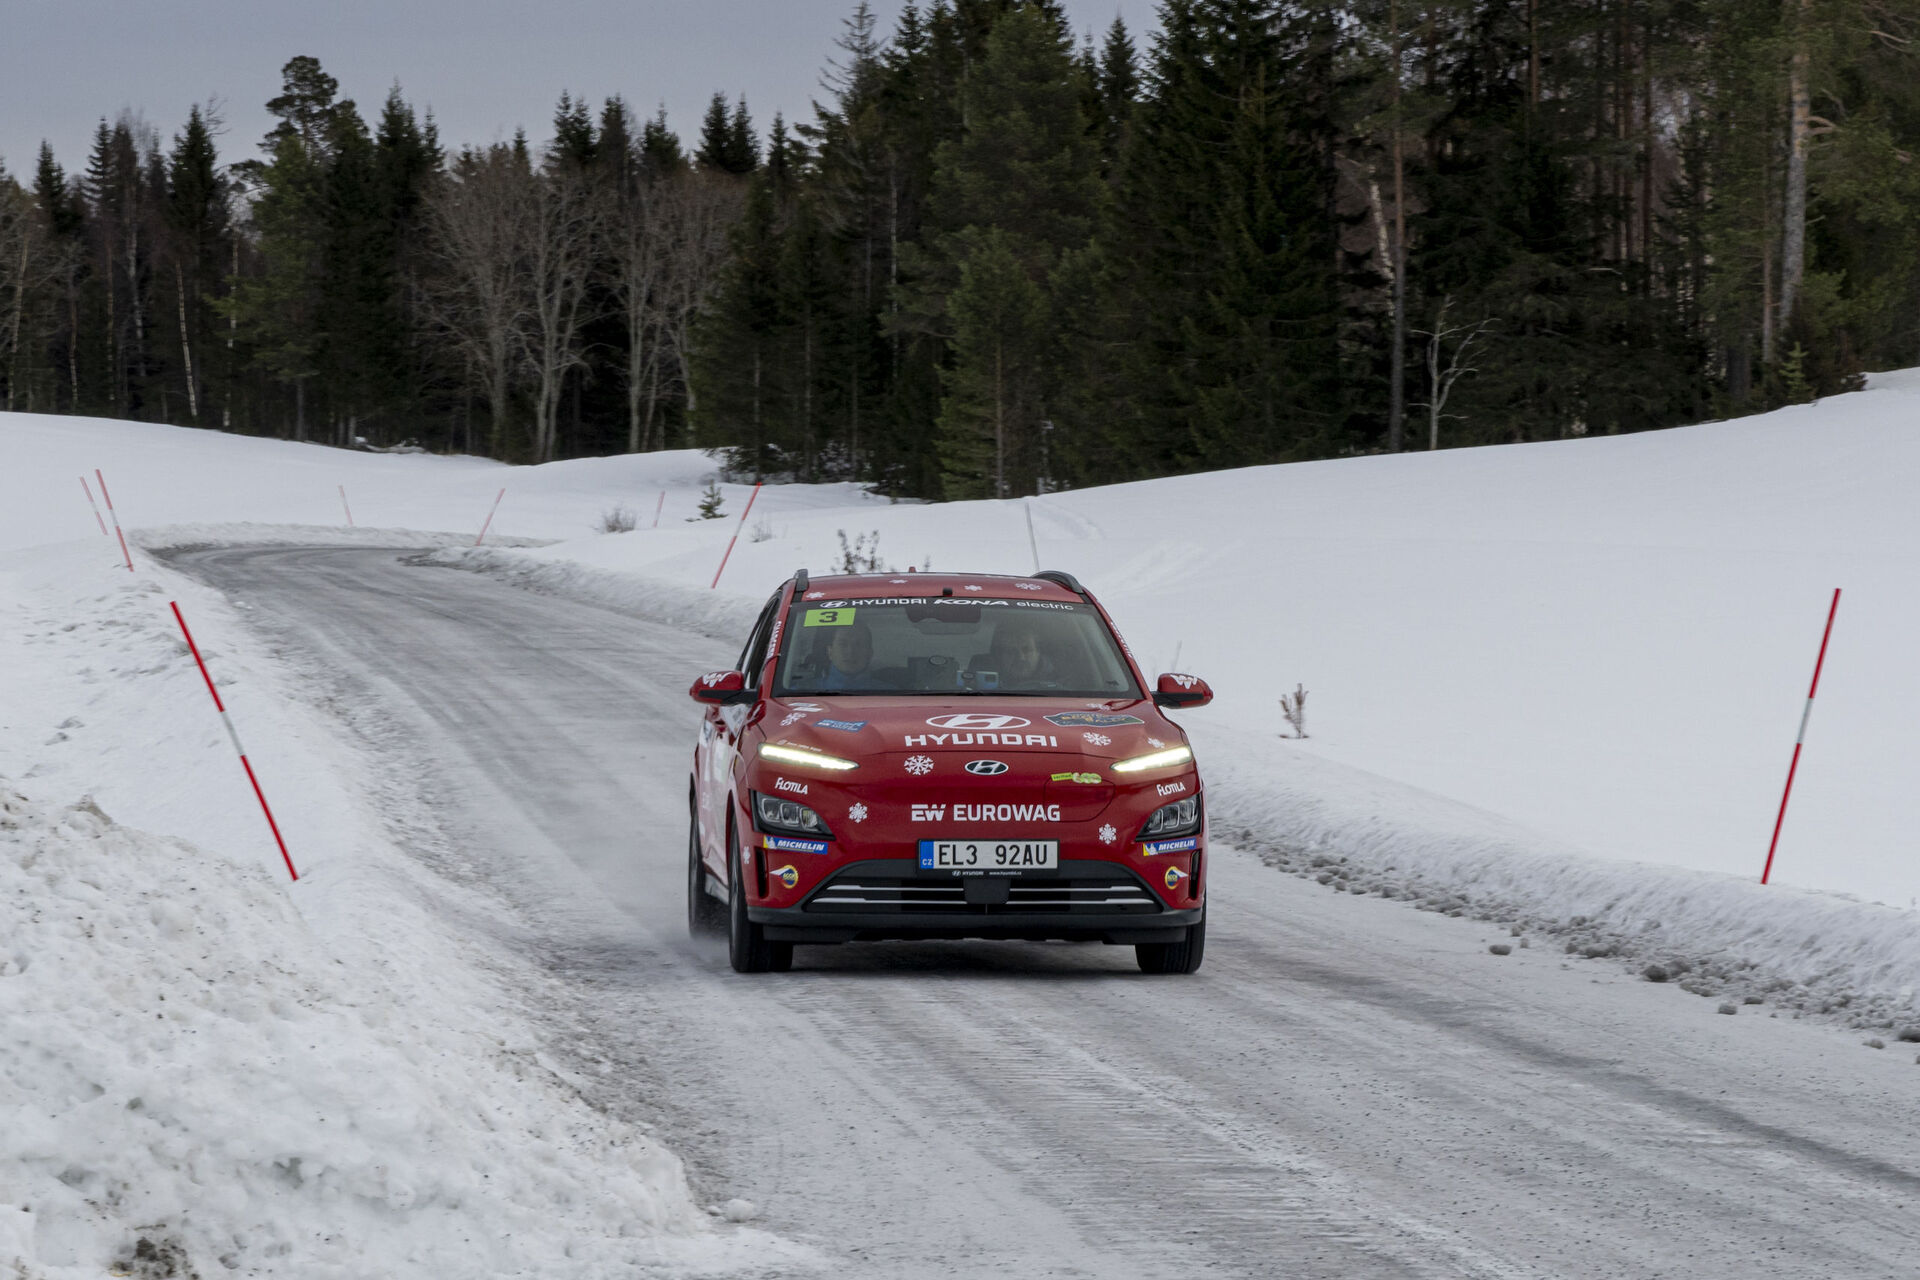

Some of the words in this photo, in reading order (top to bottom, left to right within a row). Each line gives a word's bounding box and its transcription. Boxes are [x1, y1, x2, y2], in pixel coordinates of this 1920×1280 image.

[851, 598, 927, 606] HYUNDAI
[1016, 602, 1074, 611] electric
[818, 611, 838, 624] 3
[904, 733, 1058, 747] HYUNDAI
[775, 777, 808, 795] FLOTILA
[1156, 782, 1186, 796] FLOTILA
[953, 804, 1061, 821] EUROWAG
[777, 840, 825, 851] MICHELIN
[1158, 840, 1195, 851] MICHELIN
[938, 844, 978, 866] EL3
[995, 844, 1048, 866] 92AU
[922, 858, 933, 866] CZ
